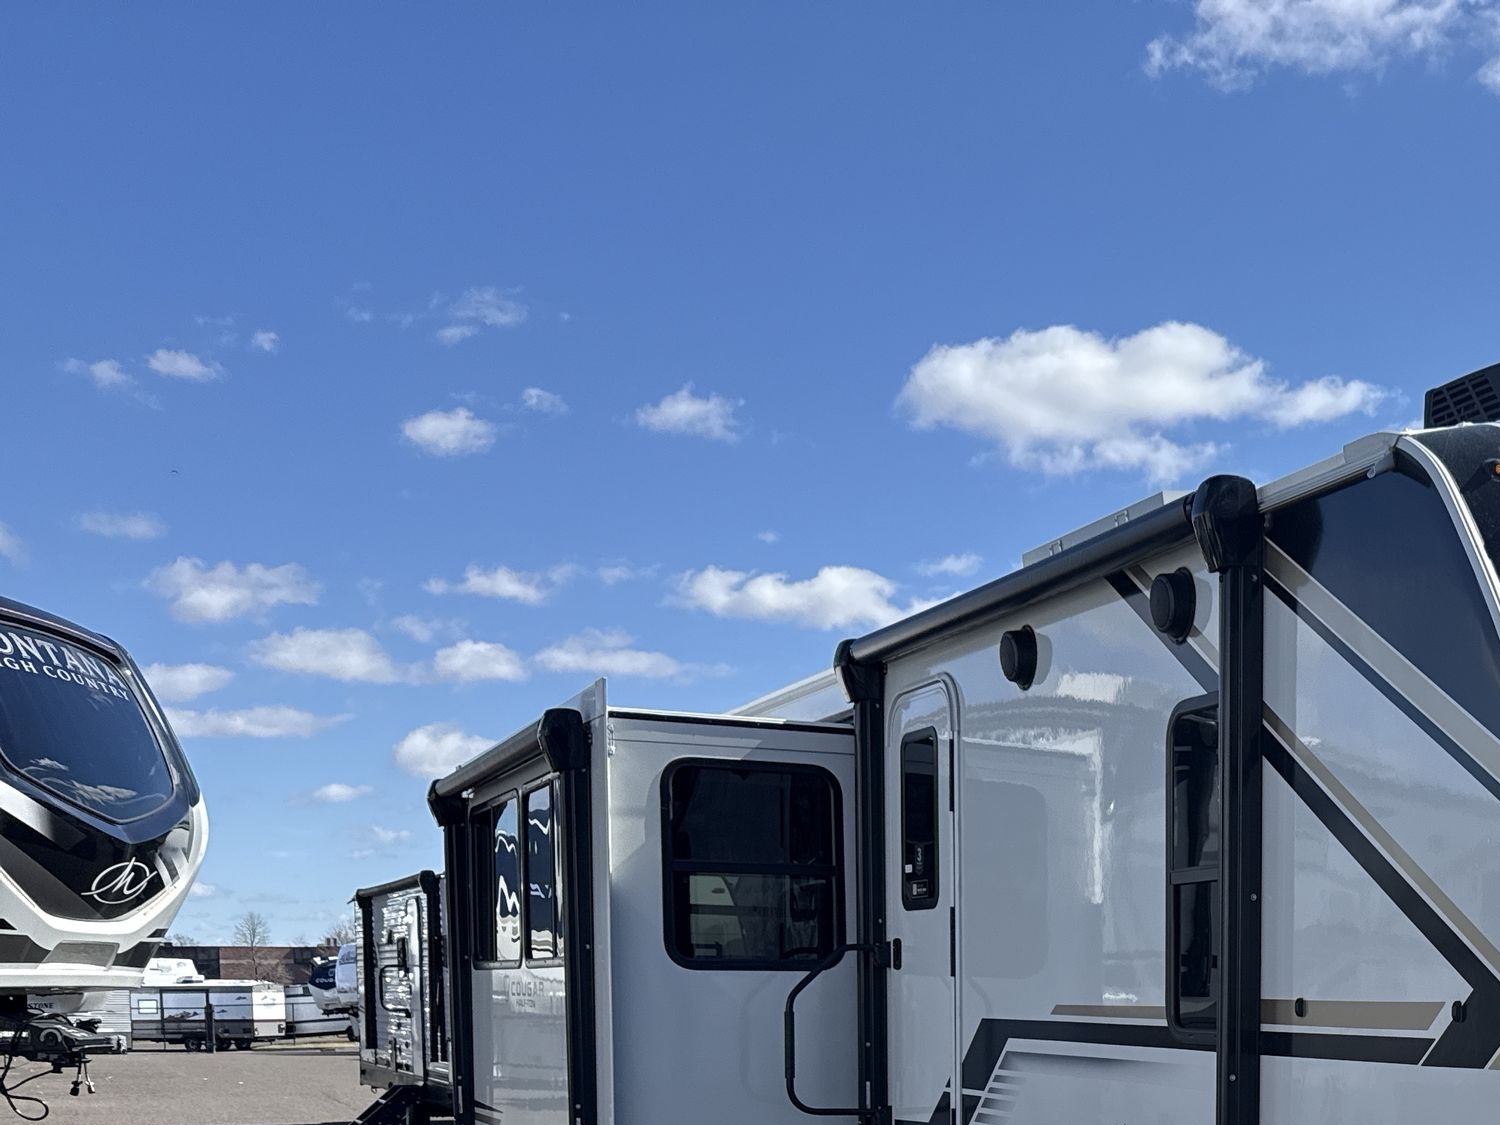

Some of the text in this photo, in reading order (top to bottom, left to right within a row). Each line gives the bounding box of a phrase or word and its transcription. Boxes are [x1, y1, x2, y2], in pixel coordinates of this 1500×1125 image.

[0, 632, 128, 690] ONTANA
[42, 665, 129, 701] COUNTRY
[511, 981, 545, 997] COUGAR
